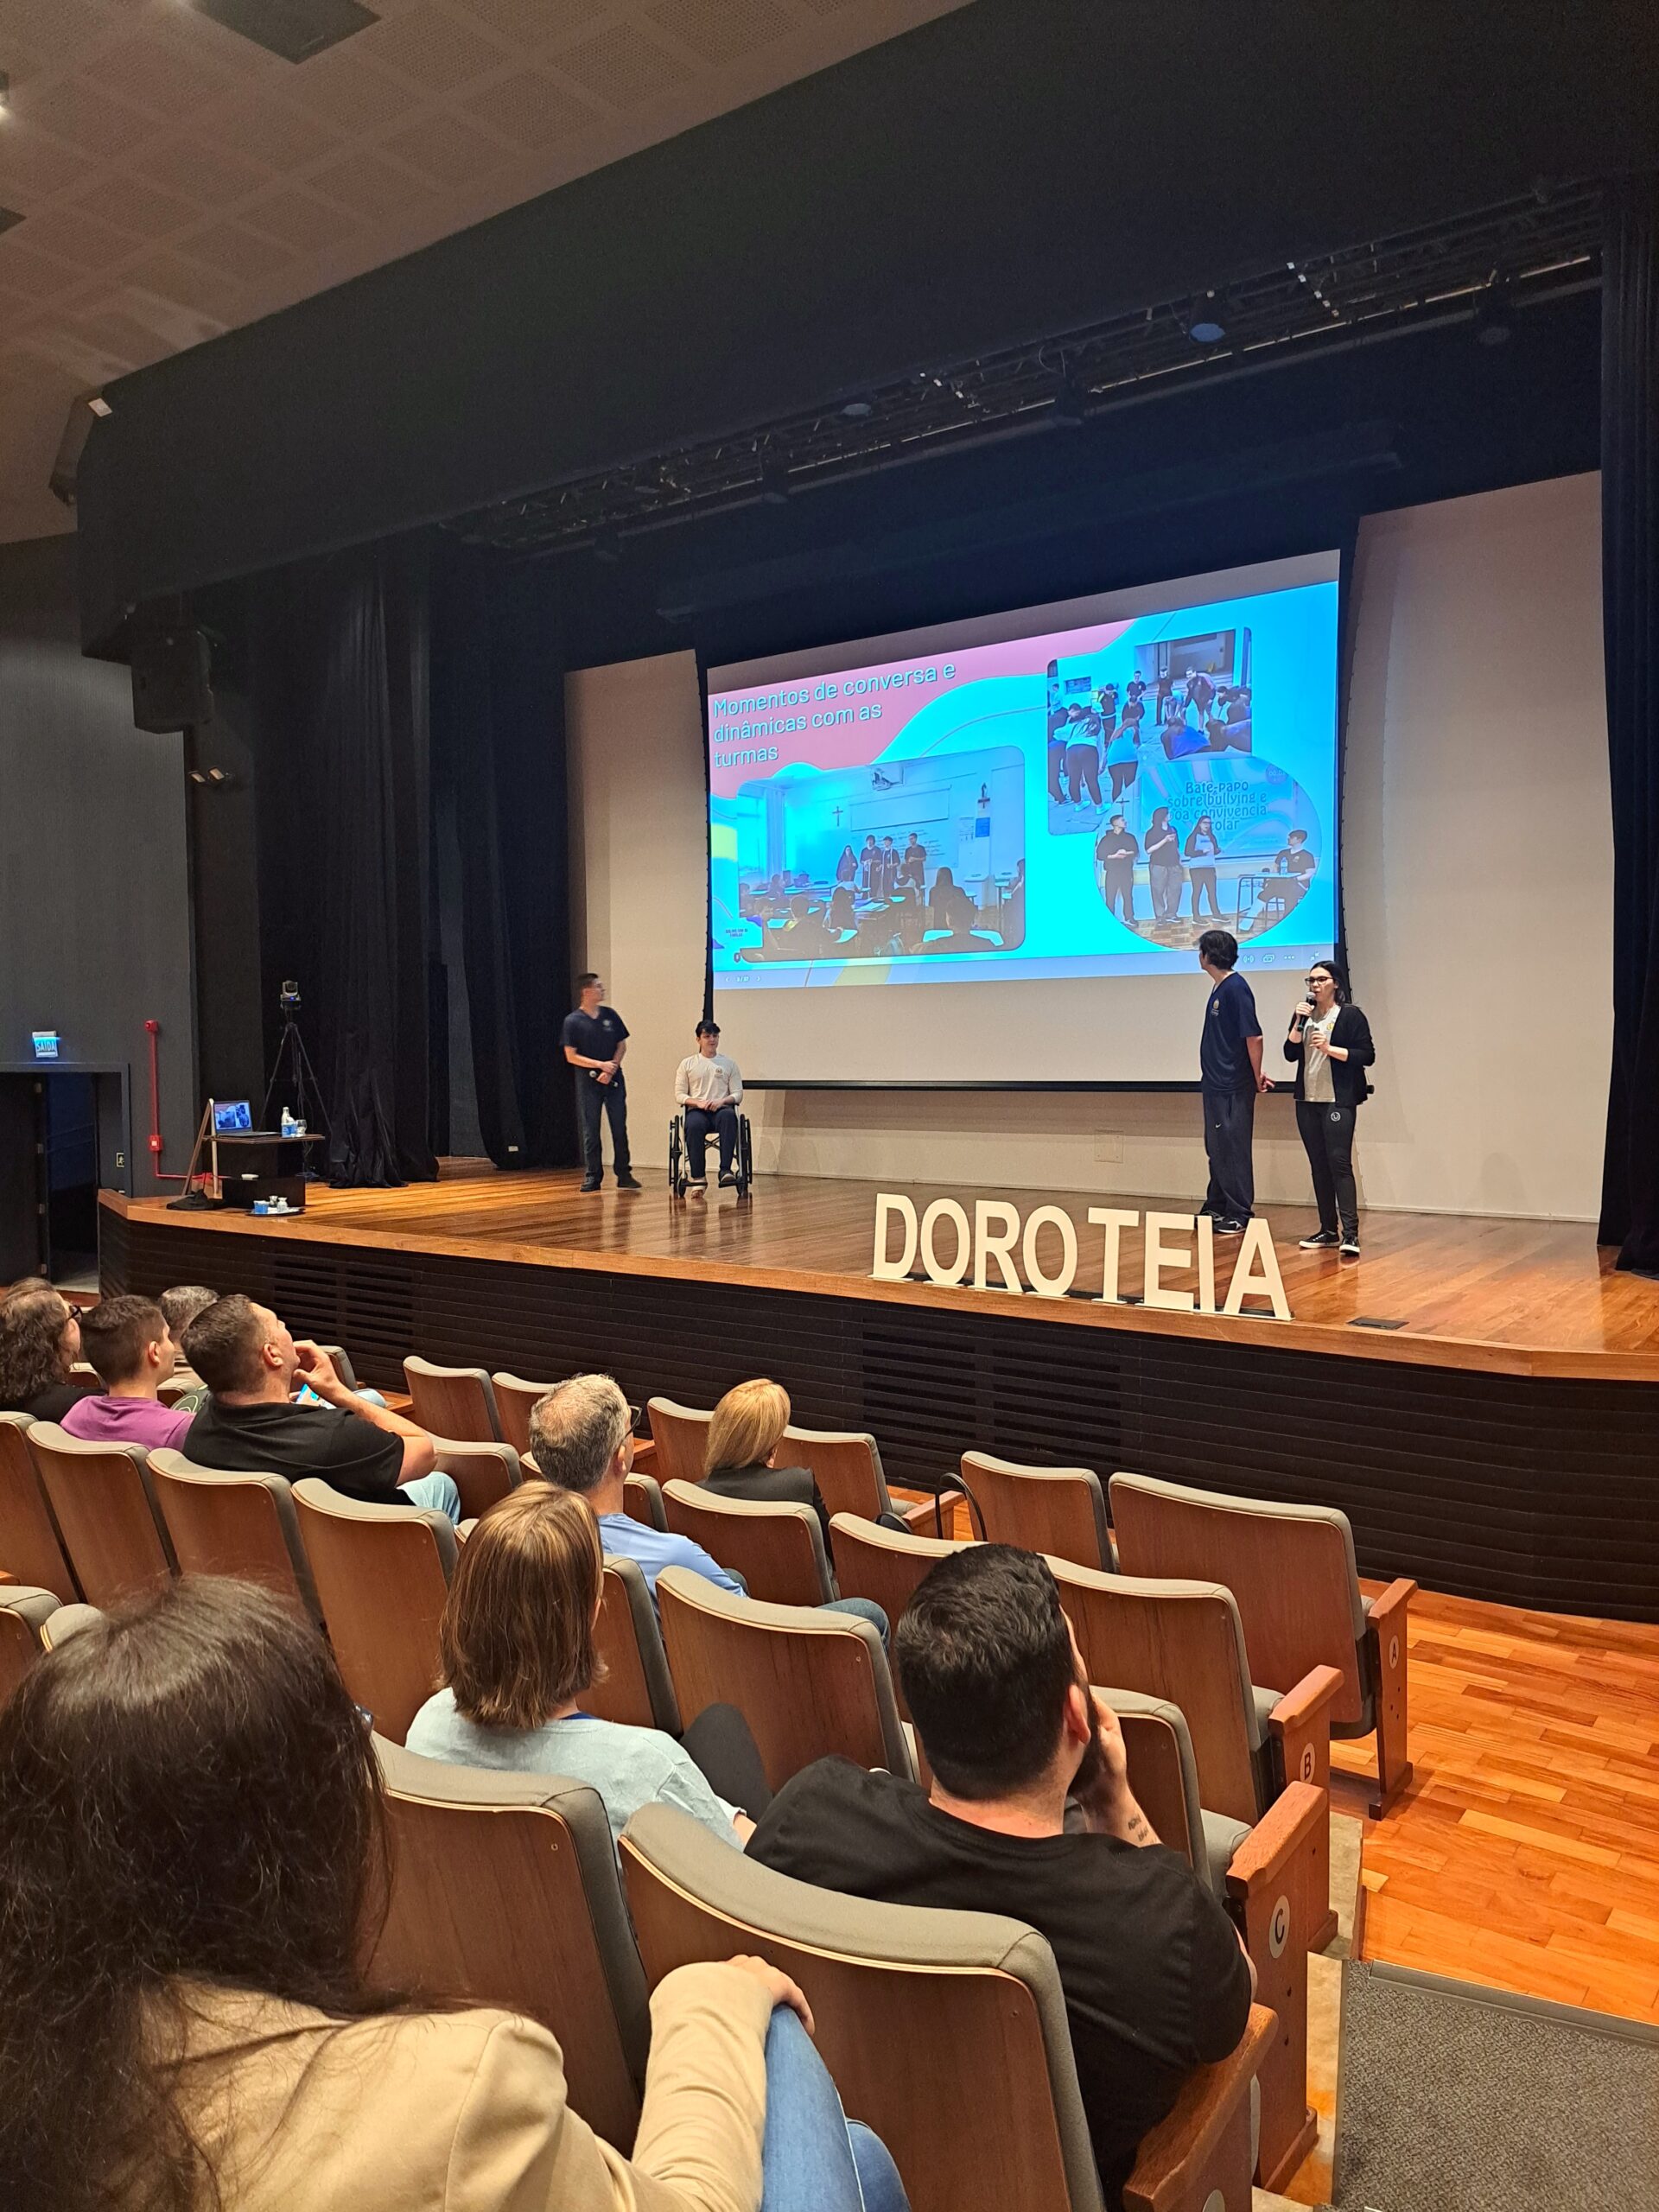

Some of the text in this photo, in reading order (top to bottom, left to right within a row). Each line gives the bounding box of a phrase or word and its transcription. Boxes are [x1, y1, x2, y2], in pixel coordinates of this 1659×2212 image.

[714, 664, 956, 718] Momentos de conversa e
[714, 704, 882, 742] dinâmicas com as
[714, 746, 779, 768] turmas
[1167, 792, 1267, 808] sobre bullying e
[873, 1193, 1293, 1320] DOROTEIA
[1391, 1642, 1397, 1664] A
[1305, 1752, 1311, 1781] B
[1274, 1908, 1285, 1944] C
